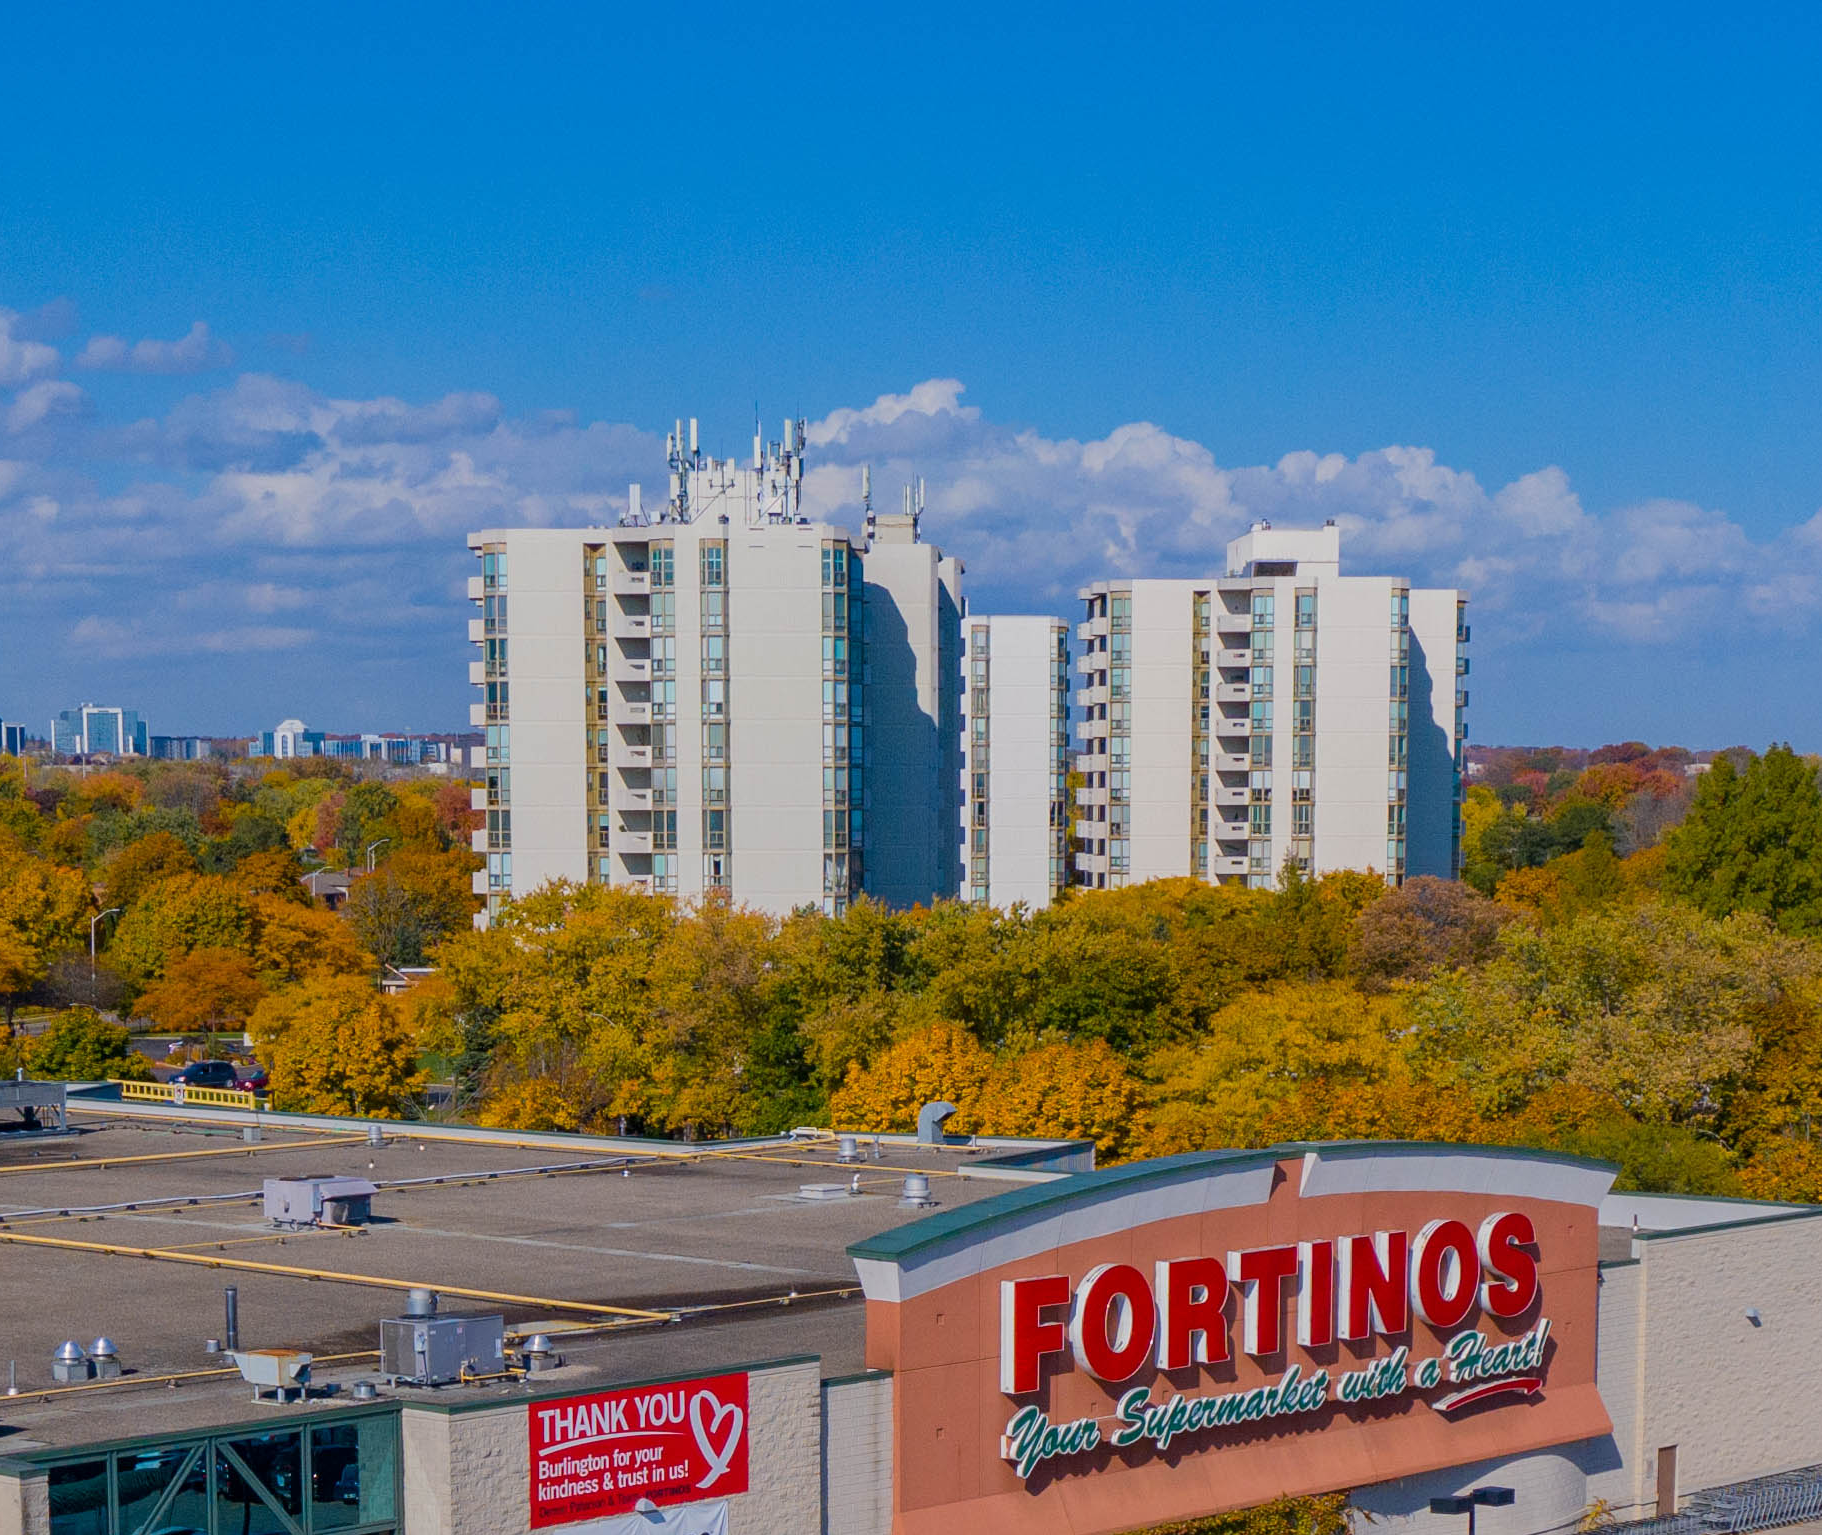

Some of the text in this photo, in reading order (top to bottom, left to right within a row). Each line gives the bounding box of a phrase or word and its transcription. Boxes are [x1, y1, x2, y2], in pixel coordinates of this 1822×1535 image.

[1000, 1211, 1539, 1395] FORTINOS
[538, 1390, 685, 1443] THANK YOU
[1007, 1318, 1552, 1479] Your Supermarket with a Heart!
[538, 1446, 663, 1479] Burlington for your
[538, 1477, 599, 1501] kindness
[603, 1472, 614, 1490] &
[618, 1467, 648, 1488] trust
[652, 1464, 665, 1482] in
[669, 1459, 689, 1479] us!
